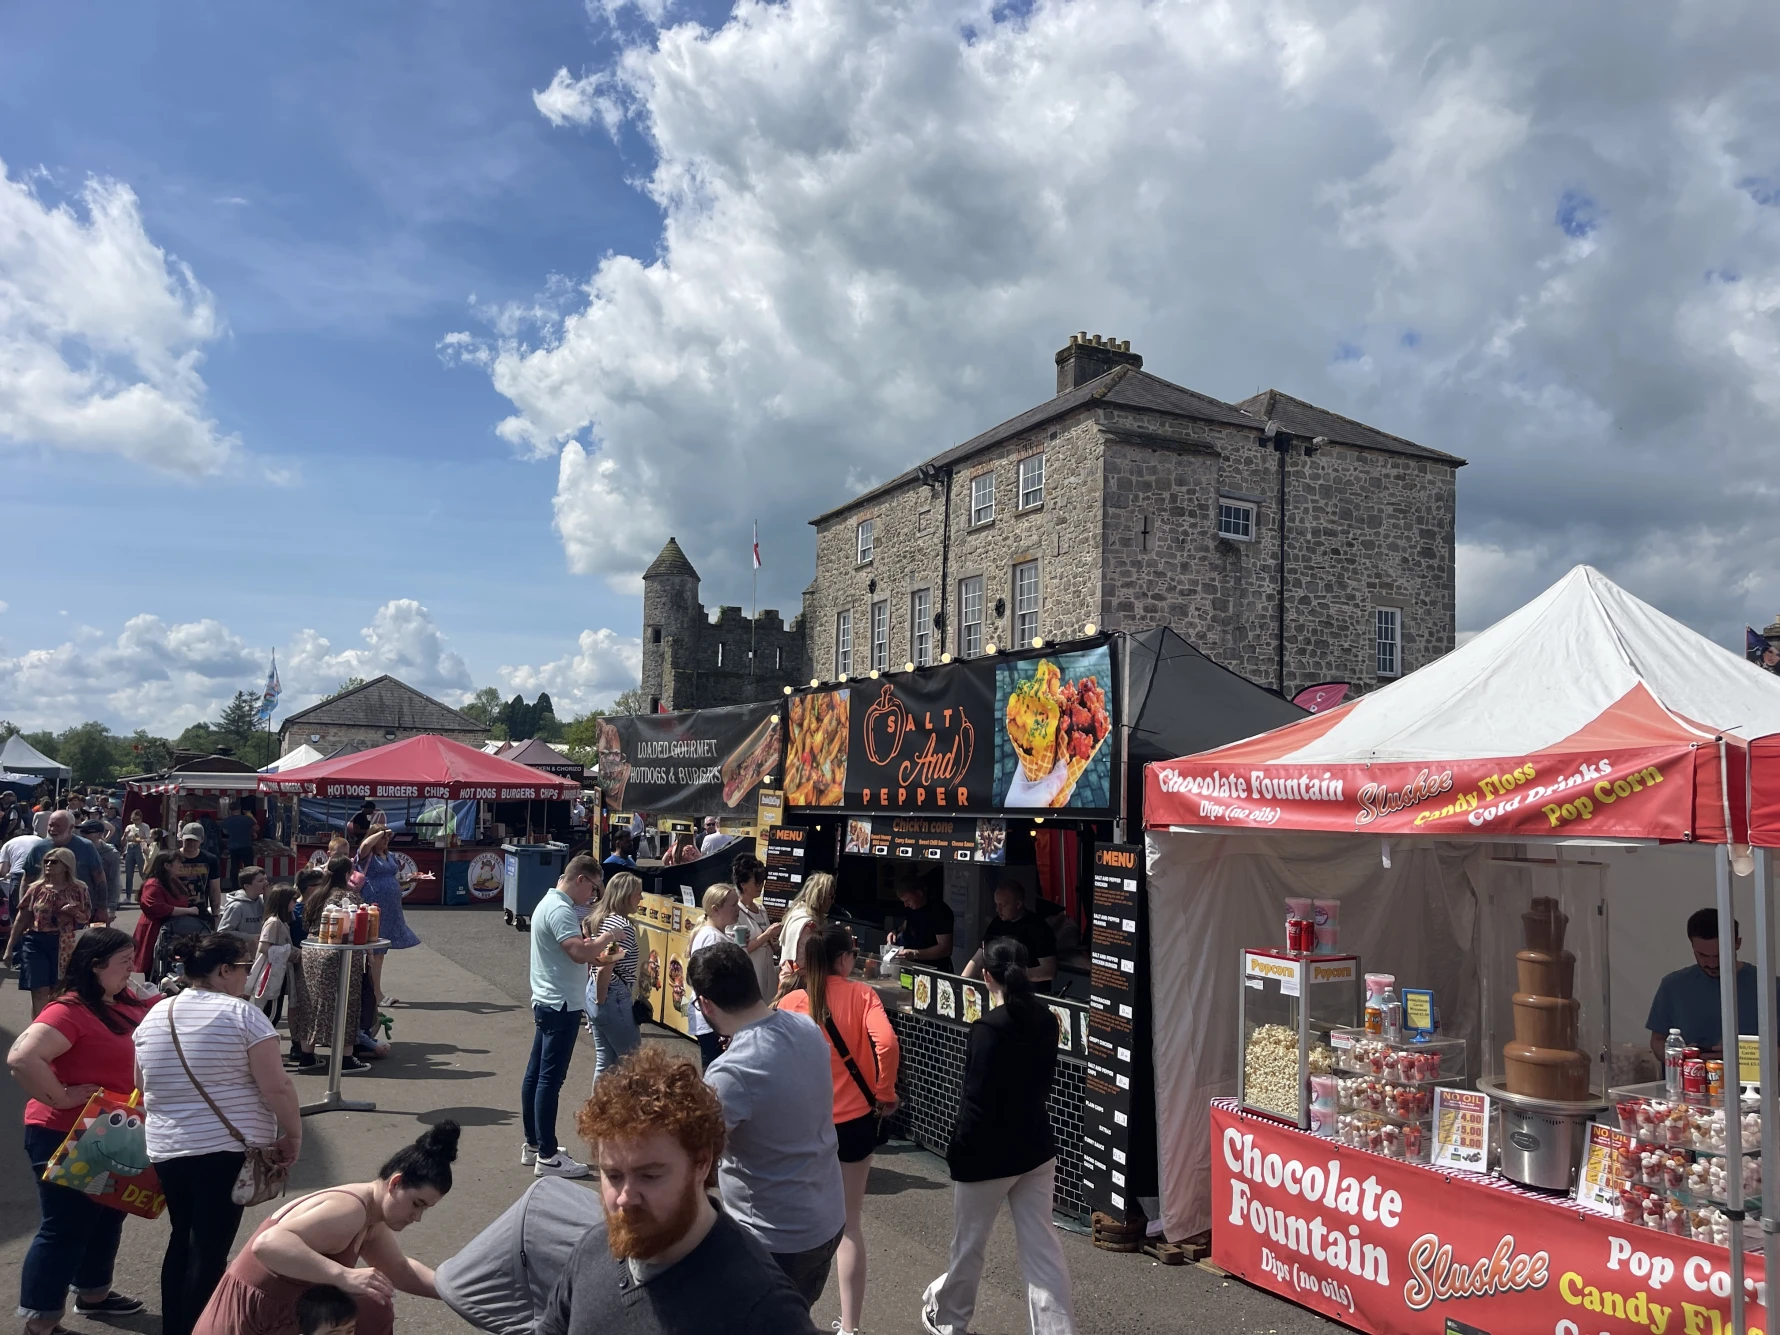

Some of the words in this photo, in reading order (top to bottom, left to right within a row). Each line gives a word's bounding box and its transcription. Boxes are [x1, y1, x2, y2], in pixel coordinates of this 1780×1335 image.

[887, 709, 953, 732] SALT
[638, 741, 669, 758] LOADED
[671, 740, 718, 758] GOURMET
[898, 732, 959, 786] And
[630, 767, 666, 784] HOTDOGS
[669, 767, 676, 784] &
[678, 766, 722, 784] BURGERS
[1158, 768, 1247, 798] Chocolate
[1250, 770, 1344, 801] Fountain
[328, 784, 344, 796] HOT
[346, 785, 370, 796] DOGS
[377, 786, 418, 796] BURGERS
[424, 786, 450, 798] CHIPS
[460, 788, 476, 798] HOT
[476, 788, 496, 798] DOGS
[502, 788, 535, 798] BURGERS
[540, 788, 558, 799] CHIPS
[862, 787, 968, 806] PEPPER
[1355, 768, 1454, 826] Slushee
[1414, 791, 1478, 826] Candy
[1478, 762, 1536, 801] Floss
[1468, 794, 1522, 826] Cold
[1524, 758, 1612, 804] Drinks
[1542, 796, 1594, 828] Pop
[1594, 766, 1664, 804] Corn
[892, 818, 928, 832] Chick'n
[930, 822, 954, 832] cone
[1200, 800, 1226, 820] Dips
[1226, 804, 1250, 821] (no
[1249, 807, 1280, 825] oils)
[776, 830, 804, 840] MENU
[1103, 850, 1134, 868] MENU
[1251, 958, 1294, 978] Popcorn
[1314, 966, 1352, 980] Popcorn
[1443, 1092, 1460, 1100] NO
[1463, 1095, 1481, 1104] OIL
[1594, 1127, 1608, 1137] NO
[1224, 1127, 1402, 1228] Chocolate
[1228, 1178, 1390, 1286] Fountain
[1404, 1233, 1550, 1312] Slushee
[1606, 1236, 1674, 1290] Pop
[1262, 1247, 1290, 1282] Dips
[1293, 1263, 1318, 1292] (no
[1321, 1277, 1354, 1313] oils)
[1559, 1272, 1672, 1335] Candy
